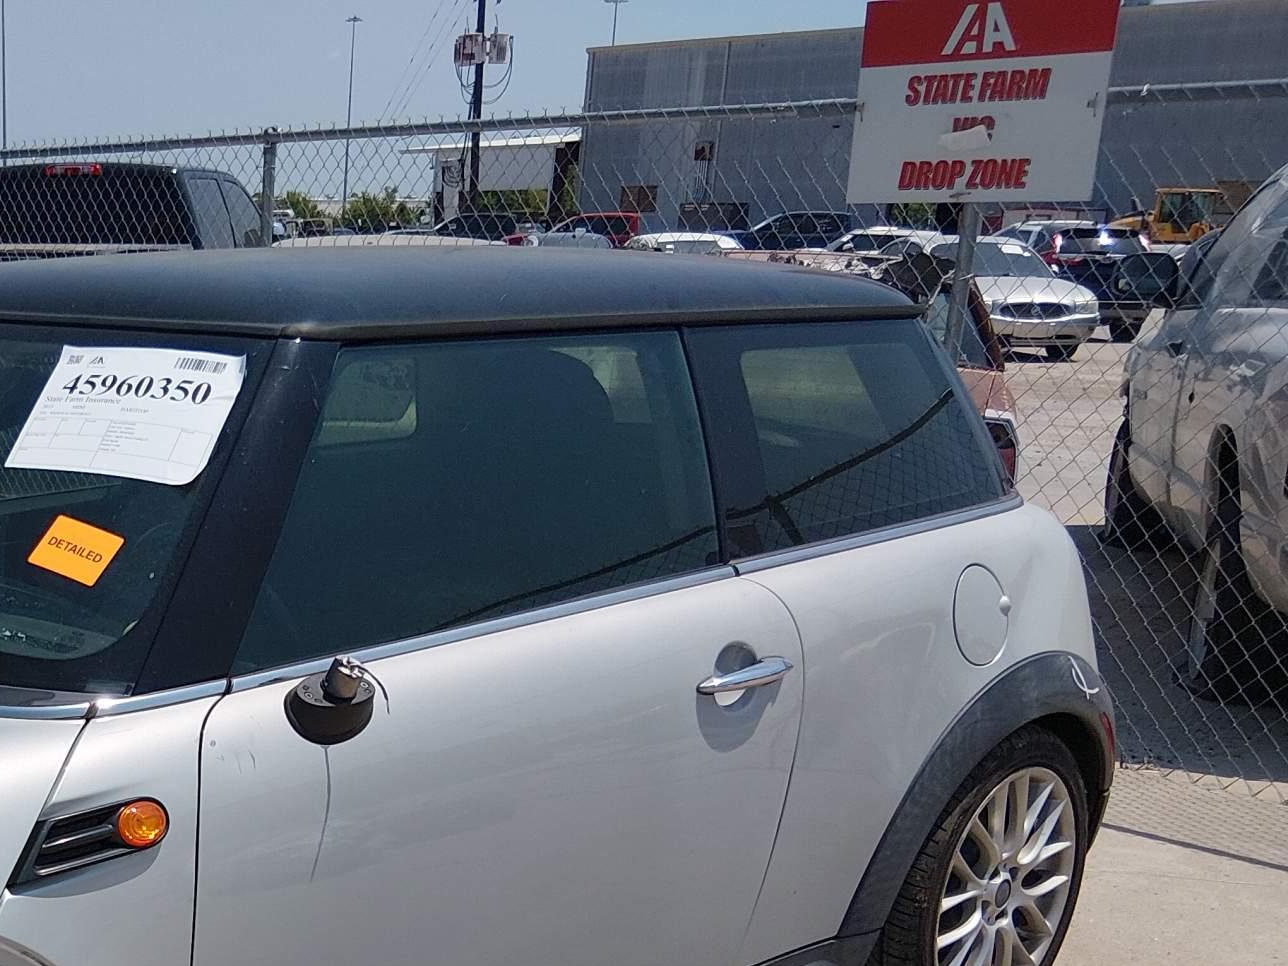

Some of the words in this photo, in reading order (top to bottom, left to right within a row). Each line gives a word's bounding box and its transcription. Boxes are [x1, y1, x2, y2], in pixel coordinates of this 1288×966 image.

[905, 72, 978, 107] STATE
[977, 67, 1052, 103] FARM
[898, 160, 966, 191] DROP
[965, 158, 1032, 190] ZONE
[62, 374, 212, 405] 45960350
[64, 395, 84, 404] Farm
[84, 396, 122, 405] Insurance
[47, 536, 103, 563] DETAILED
